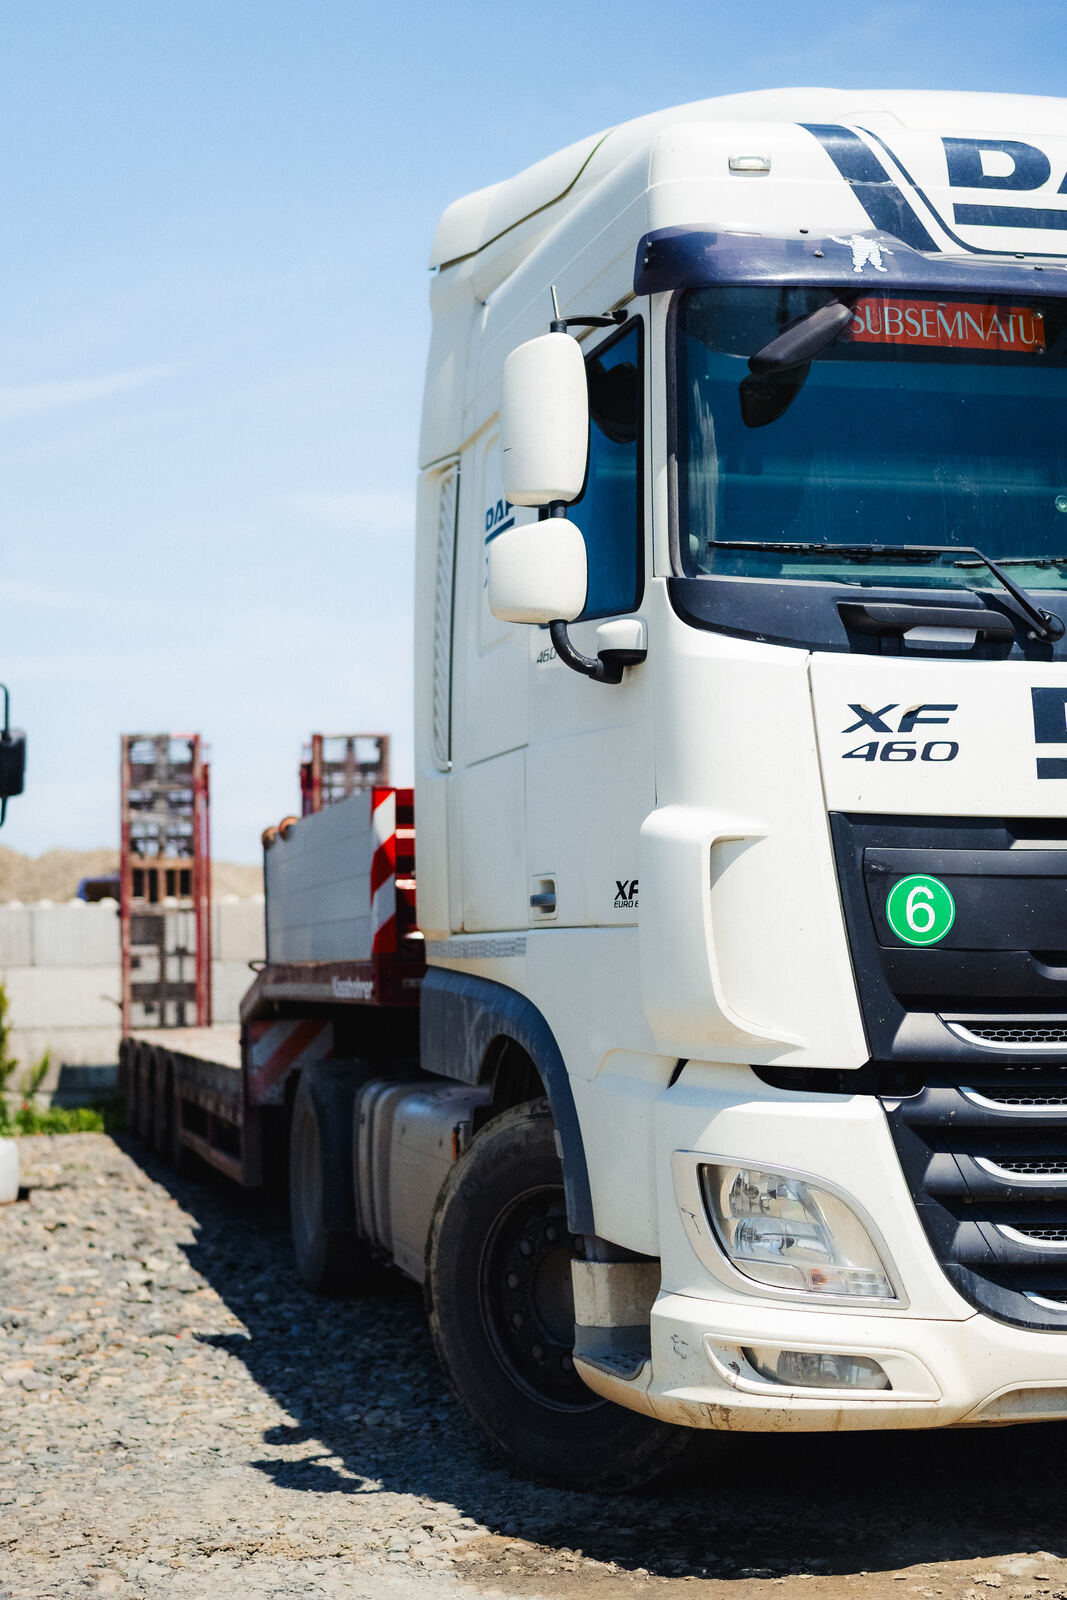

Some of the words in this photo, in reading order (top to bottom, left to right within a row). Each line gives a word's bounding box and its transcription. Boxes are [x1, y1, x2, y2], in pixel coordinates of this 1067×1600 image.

[940, 136, 1067, 194] D
[841, 703, 959, 734] XF
[841, 741, 960, 762] 460
[614, 879, 639, 900] XF
[613, 900, 634, 908] EURO
[905, 886, 936, 933] 6
